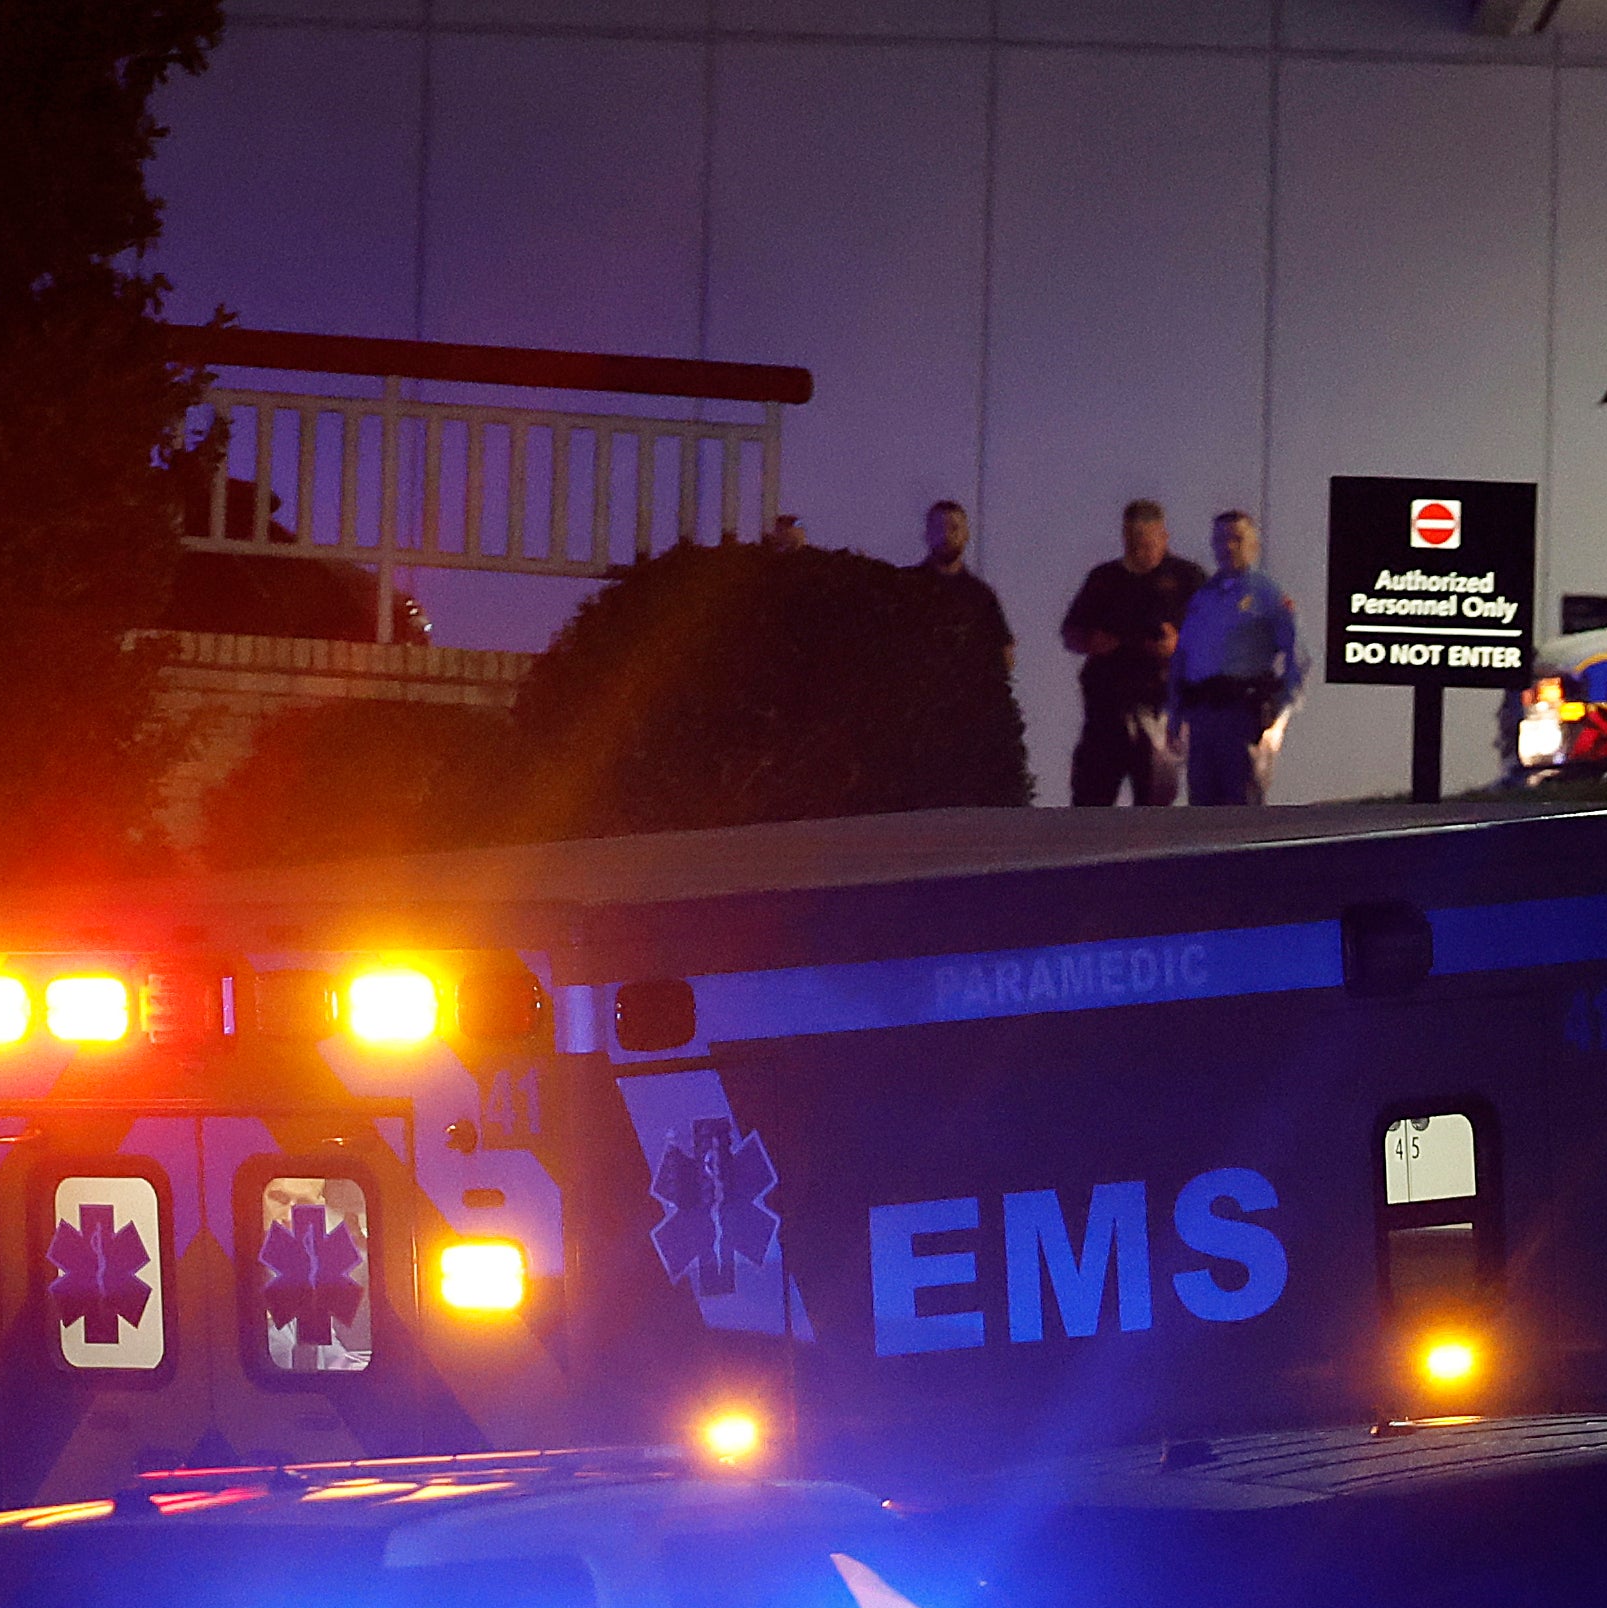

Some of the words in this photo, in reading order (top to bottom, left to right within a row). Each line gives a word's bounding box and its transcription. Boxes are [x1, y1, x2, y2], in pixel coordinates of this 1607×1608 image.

[1374, 569, 1495, 594] Authorized
[1350, 593, 1458, 616] Personnel
[1461, 595, 1519, 625] Only
[1345, 642, 1386, 664] DO
[1390, 644, 1444, 665] NOT
[1448, 646, 1522, 668] ENTER
[933, 942, 1212, 1003] PARAMEDIC
[1395, 1138, 1404, 1160] 4
[1412, 1136, 1420, 1159] 5
[868, 1166, 1289, 1358] EMS
